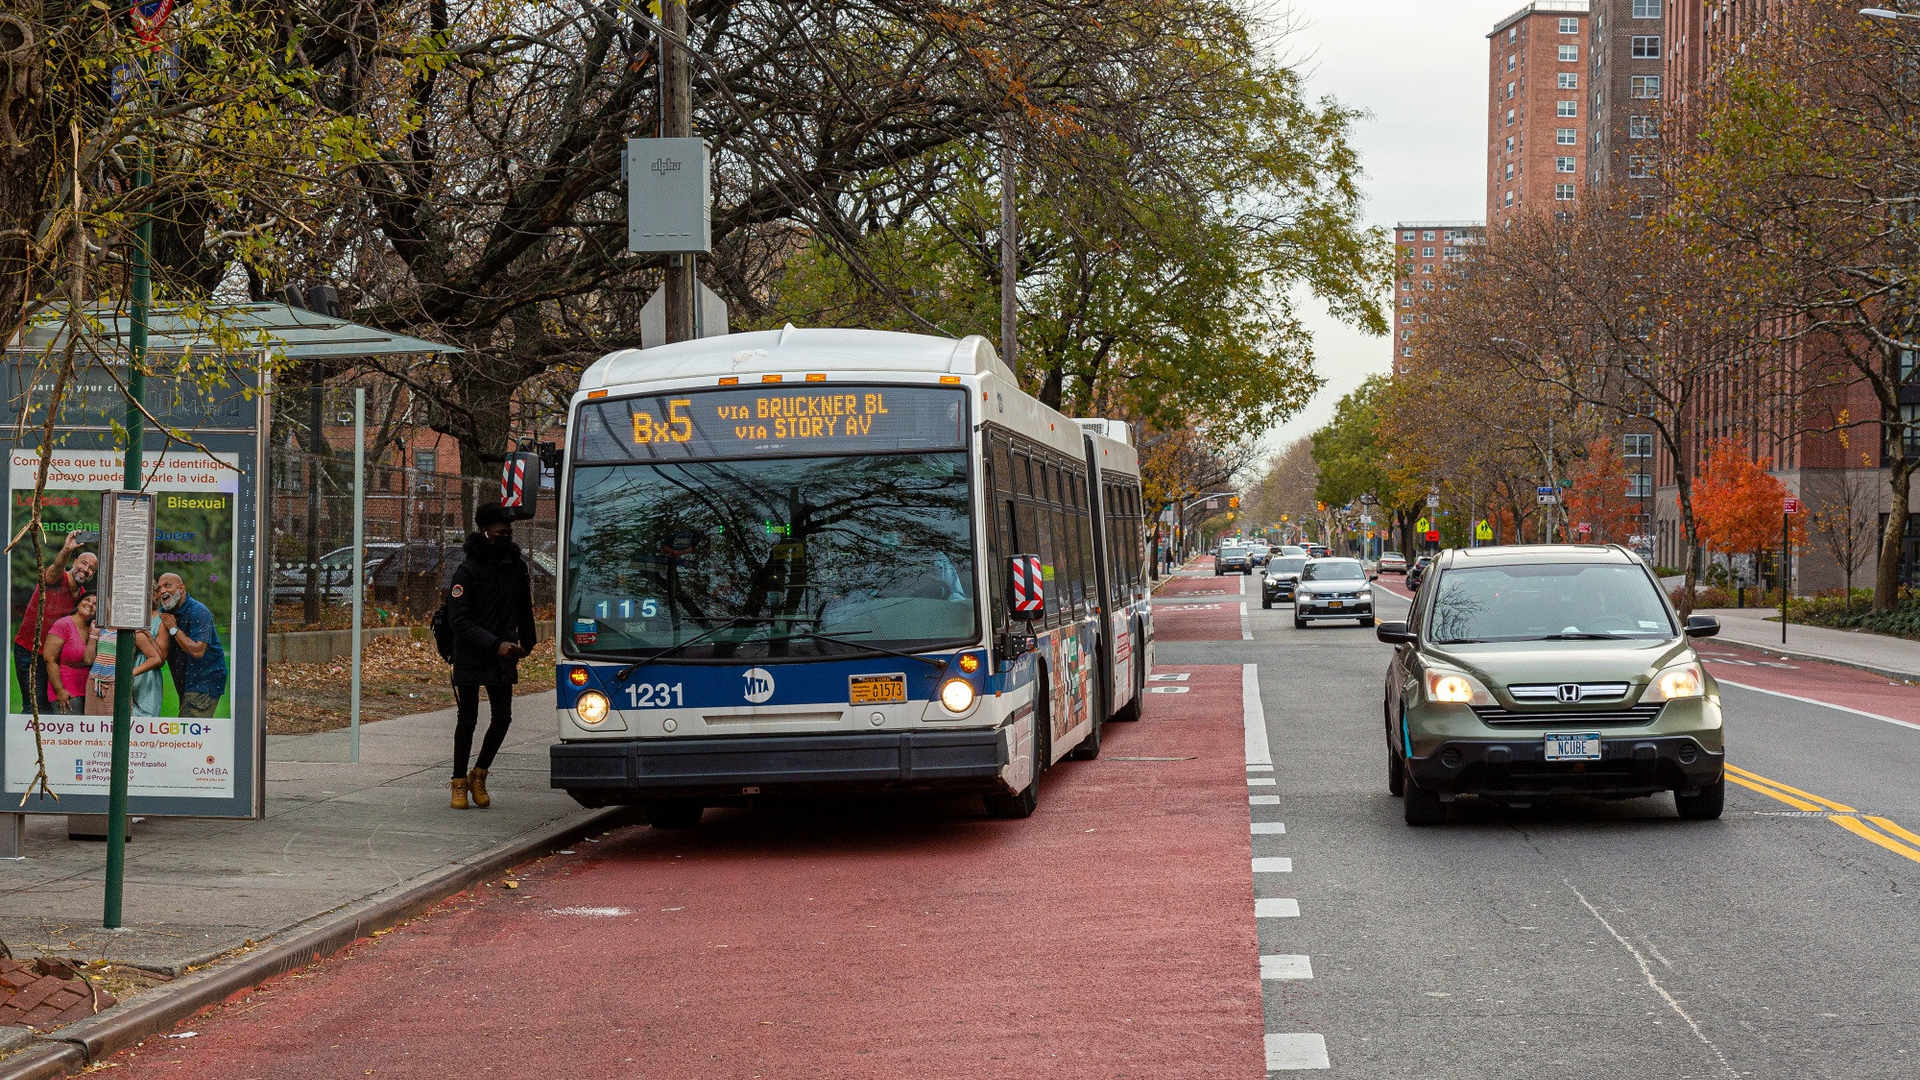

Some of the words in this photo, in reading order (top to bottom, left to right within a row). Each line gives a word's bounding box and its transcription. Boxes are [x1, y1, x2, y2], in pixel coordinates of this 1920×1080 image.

[717, 405, 750, 420] VIA
[757, 395, 857, 418] BRUCKNER
[865, 394, 888, 414] BL
[633, 399, 692, 443] Bx5
[735, 425, 767, 440] VIA
[775, 416, 837, 439] STORY
[846, 414, 872, 435] AV
[13, 456, 41, 466] Com
[51, 458, 70, 467] sea
[74, 459, 96, 468] que
[99, 458, 111, 467] tu
[152, 460, 165, 469] se
[48, 472, 85, 482] apoyo
[88, 472, 125, 482] puede
[141, 473, 173, 483] lvarle
[176, 473, 187, 482] la
[190, 474, 218, 484] vida.
[16, 494, 80, 507] Lebiana
[167, 496, 226, 510] Bisexual
[744, 676, 769, 697] MTA
[879, 682, 903, 697] 1573
[625, 682, 684, 708] 1231
[25, 719, 75, 735] Apoya
[80, 721, 95, 733] tu
[100, 720, 145, 734] hi/o
[150, 721, 211, 735] LGBTQ+
[58, 738, 83, 746] saber
[85, 739, 106, 747] más:
[1558, 741, 1587, 755] NCUBE
[192, 767, 229, 776] CAMBA
